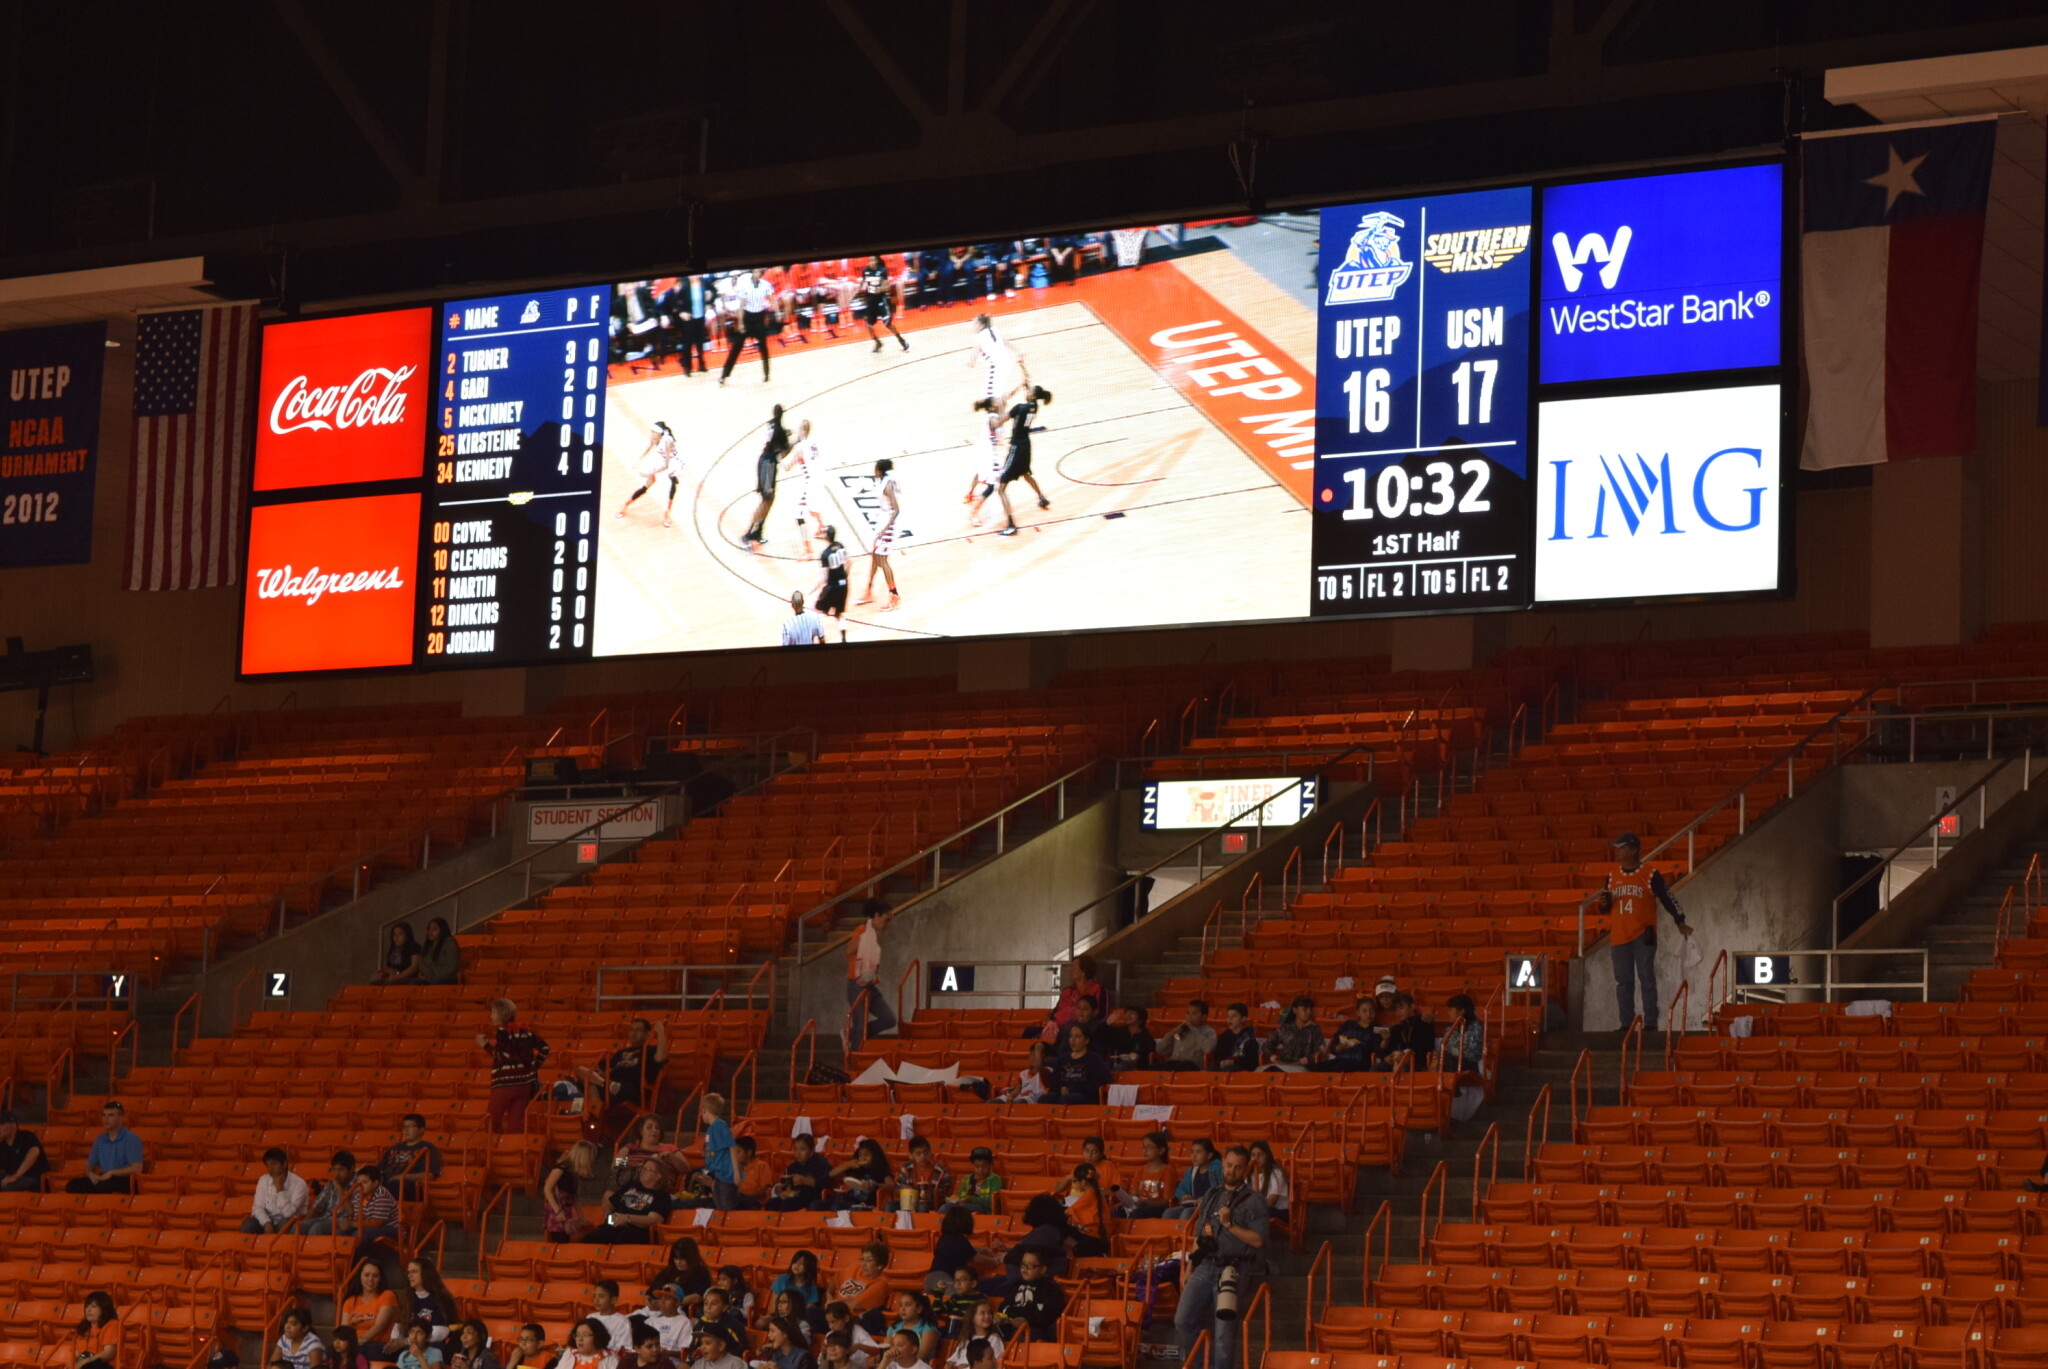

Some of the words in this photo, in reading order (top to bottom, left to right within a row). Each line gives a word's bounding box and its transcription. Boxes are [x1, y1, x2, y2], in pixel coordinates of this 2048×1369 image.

[1424, 225, 1531, 256] SOUTHERN
[1452, 251, 1495, 272] MISS
[1336, 270, 1405, 290] UTEP
[464, 306, 499, 330] NAME
[567, 298, 577, 321] P
[590, 295, 600, 319] F
[1551, 300, 1674, 335] WestStar
[1336, 316, 1400, 359] UTEP
[1447, 306, 1503, 349] USM
[447, 353, 456, 374] 2
[463, 347, 508, 373] TURNER
[565, 341, 576, 364] 3
[588, 338, 599, 362] 0
[1150, 320, 1302, 400] UTEP
[10, 365, 70, 401] UTEP
[270, 365, 417, 434] Coca-Cola
[445, 380, 454, 401] 4
[460, 377, 488, 400] GARI
[564, 369, 574, 392] 2
[587, 366, 597, 389] 0
[1343, 368, 1390, 433] 16
[1452, 360, 1498, 425] 17
[444, 408, 453, 428] 5
[459, 401, 523, 427] MCKINNEY
[562, 396, 573, 419] 0
[585, 394, 596, 417] 0
[9, 416, 64, 447] NCAA
[439, 435, 455, 456] 25
[457, 428, 521, 455] KIRSTEINE
[560, 424, 571, 447] 0
[584, 422, 595, 445] 0
[437, 463, 453, 484] 34
[456, 457, 512, 482] KENNEDY
[557, 452, 568, 475] 4
[582, 450, 593, 473] 0
[1342, 460, 1491, 520] 10:32
[1548, 448, 1768, 540] IMG
[3, 492, 59, 524] 2012
[433, 522, 450, 543] 00
[452, 520, 492, 544] COYNE
[555, 512, 566, 536] 0
[579, 511, 590, 534] 0
[1372, 534, 1412, 555] 1ST
[1418, 530, 1459, 552] Half
[433, 549, 448, 571] 10
[451, 546, 508, 572] CLEMONS
[554, 540, 565, 564] 2
[578, 539, 589, 562] 0
[257, 565, 403, 606] Walgreens
[433, 577, 446, 598] 11
[449, 575, 496, 600] MARTIN
[552, 568, 563, 592] 0
[576, 567, 587, 591] 0
[1318, 577, 1337, 600] TO
[1342, 575, 1352, 599] 5
[1368, 574, 1386, 598] FL
[1393, 573, 1403, 596] 2
[1422, 571, 1440, 595] TO
[1446, 569, 1456, 593] 5
[1471, 567, 1490, 592] FL
[1498, 566, 1508, 590] 2
[430, 605, 445, 626] 12
[448, 602, 499, 626] DINKINS
[551, 597, 561, 620] 5
[575, 595, 586, 619] 0
[427, 632, 444, 654] 20
[446, 630, 495, 654] JORDAN
[549, 625, 560, 649] 2
[573, 623, 584, 648] 0
[534, 809, 592, 825] STUDENT
[597, 807, 653, 823] SECTION
[1612, 885, 1644, 898] MINERS
[1619, 899, 1634, 915] 14
[112, 975, 124, 997] Y
[272, 974, 285, 996] Z
[941, 966, 958, 991] A
[1516, 960, 1535, 987] A
[1755, 956, 1774, 984] B
